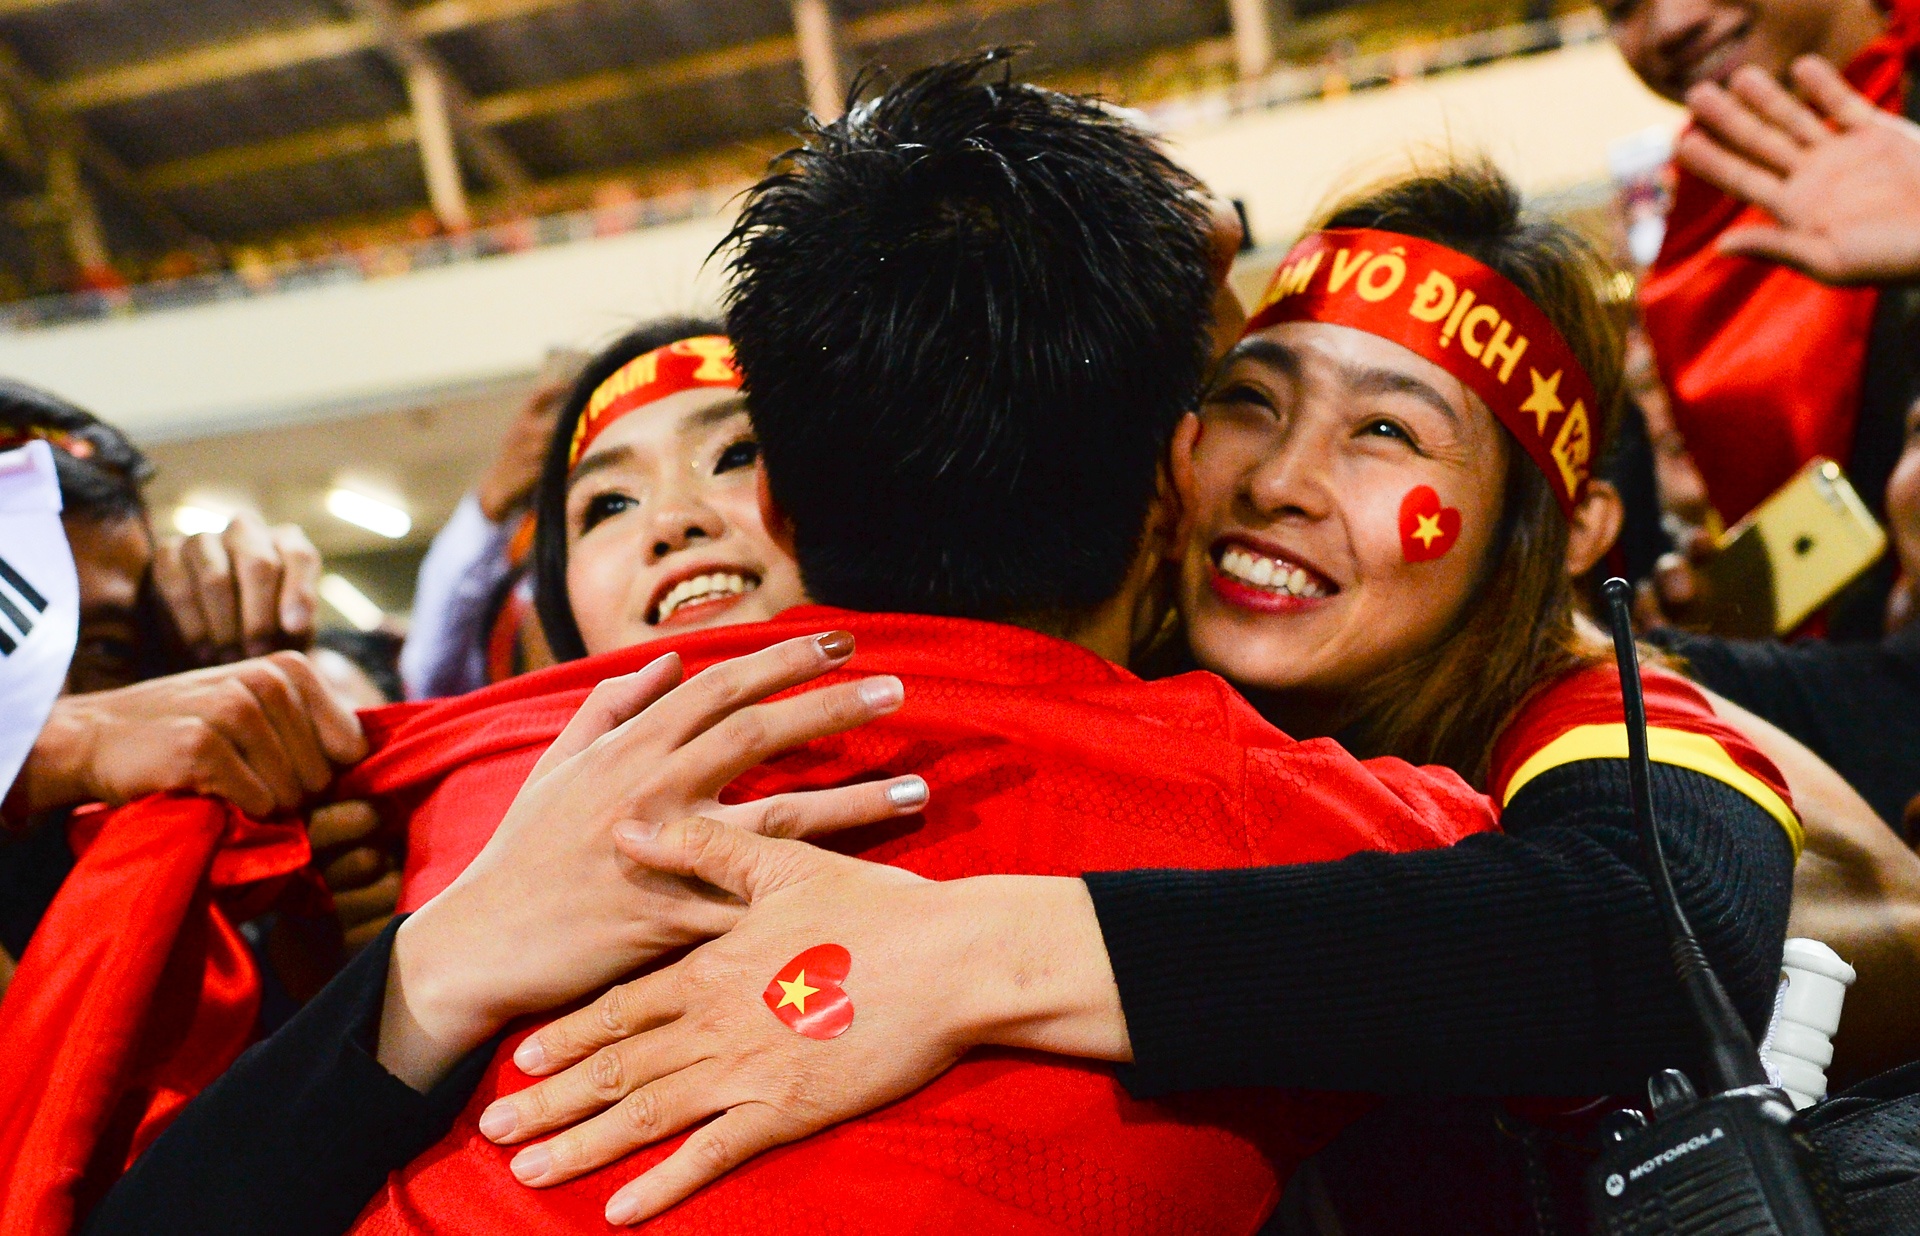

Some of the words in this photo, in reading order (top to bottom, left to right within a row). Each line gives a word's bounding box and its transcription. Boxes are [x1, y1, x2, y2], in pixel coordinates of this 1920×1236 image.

[1327, 246, 1407, 303] VÔ
[1409, 269, 1529, 384] ĐỊCH
[589, 352, 658, 421] NAM
[1629, 1127, 1725, 1181] MOTOROLA
